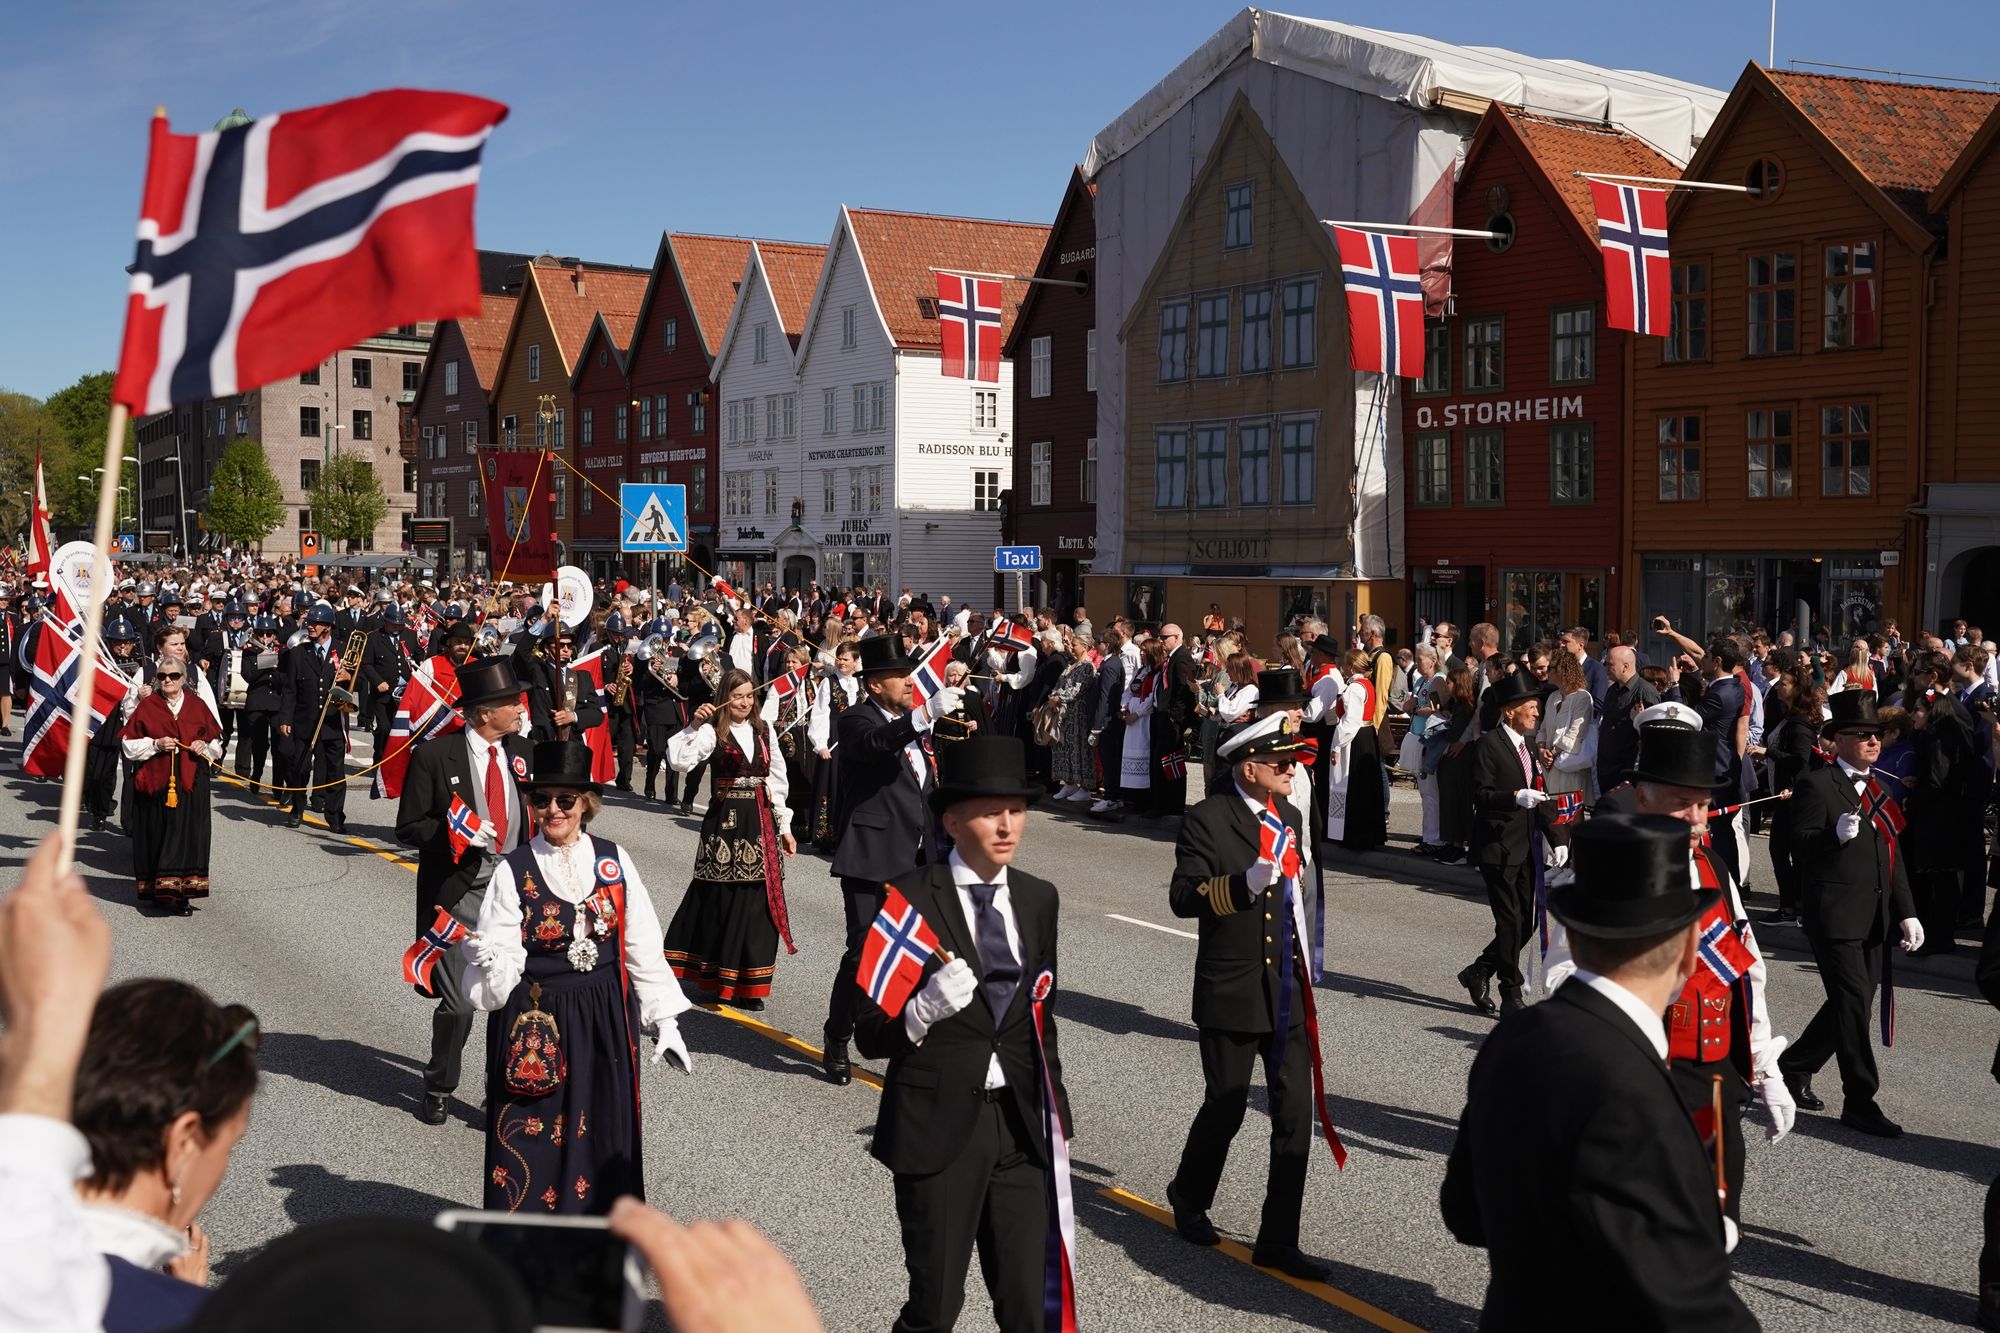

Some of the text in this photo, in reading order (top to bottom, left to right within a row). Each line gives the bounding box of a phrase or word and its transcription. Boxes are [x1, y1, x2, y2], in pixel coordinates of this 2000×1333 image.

[1416, 395, 1583, 429] O. STORHEIM
[640, 448, 706, 465] BRYGGEN NIGHTCLUB
[808, 449, 836, 462] NETWORK
[836, 446, 873, 458] CHARTERING
[918, 443, 975, 456] RADISSON
[979, 445, 1000, 457] BLU
[584, 456, 606, 469] MADAM
[306, 537, 314, 546] A
[824, 533, 892, 546] SILVER GALLERY
[1194, 537, 1271, 560] SCHJØTT
[1003, 551, 1034, 566] Taxi
